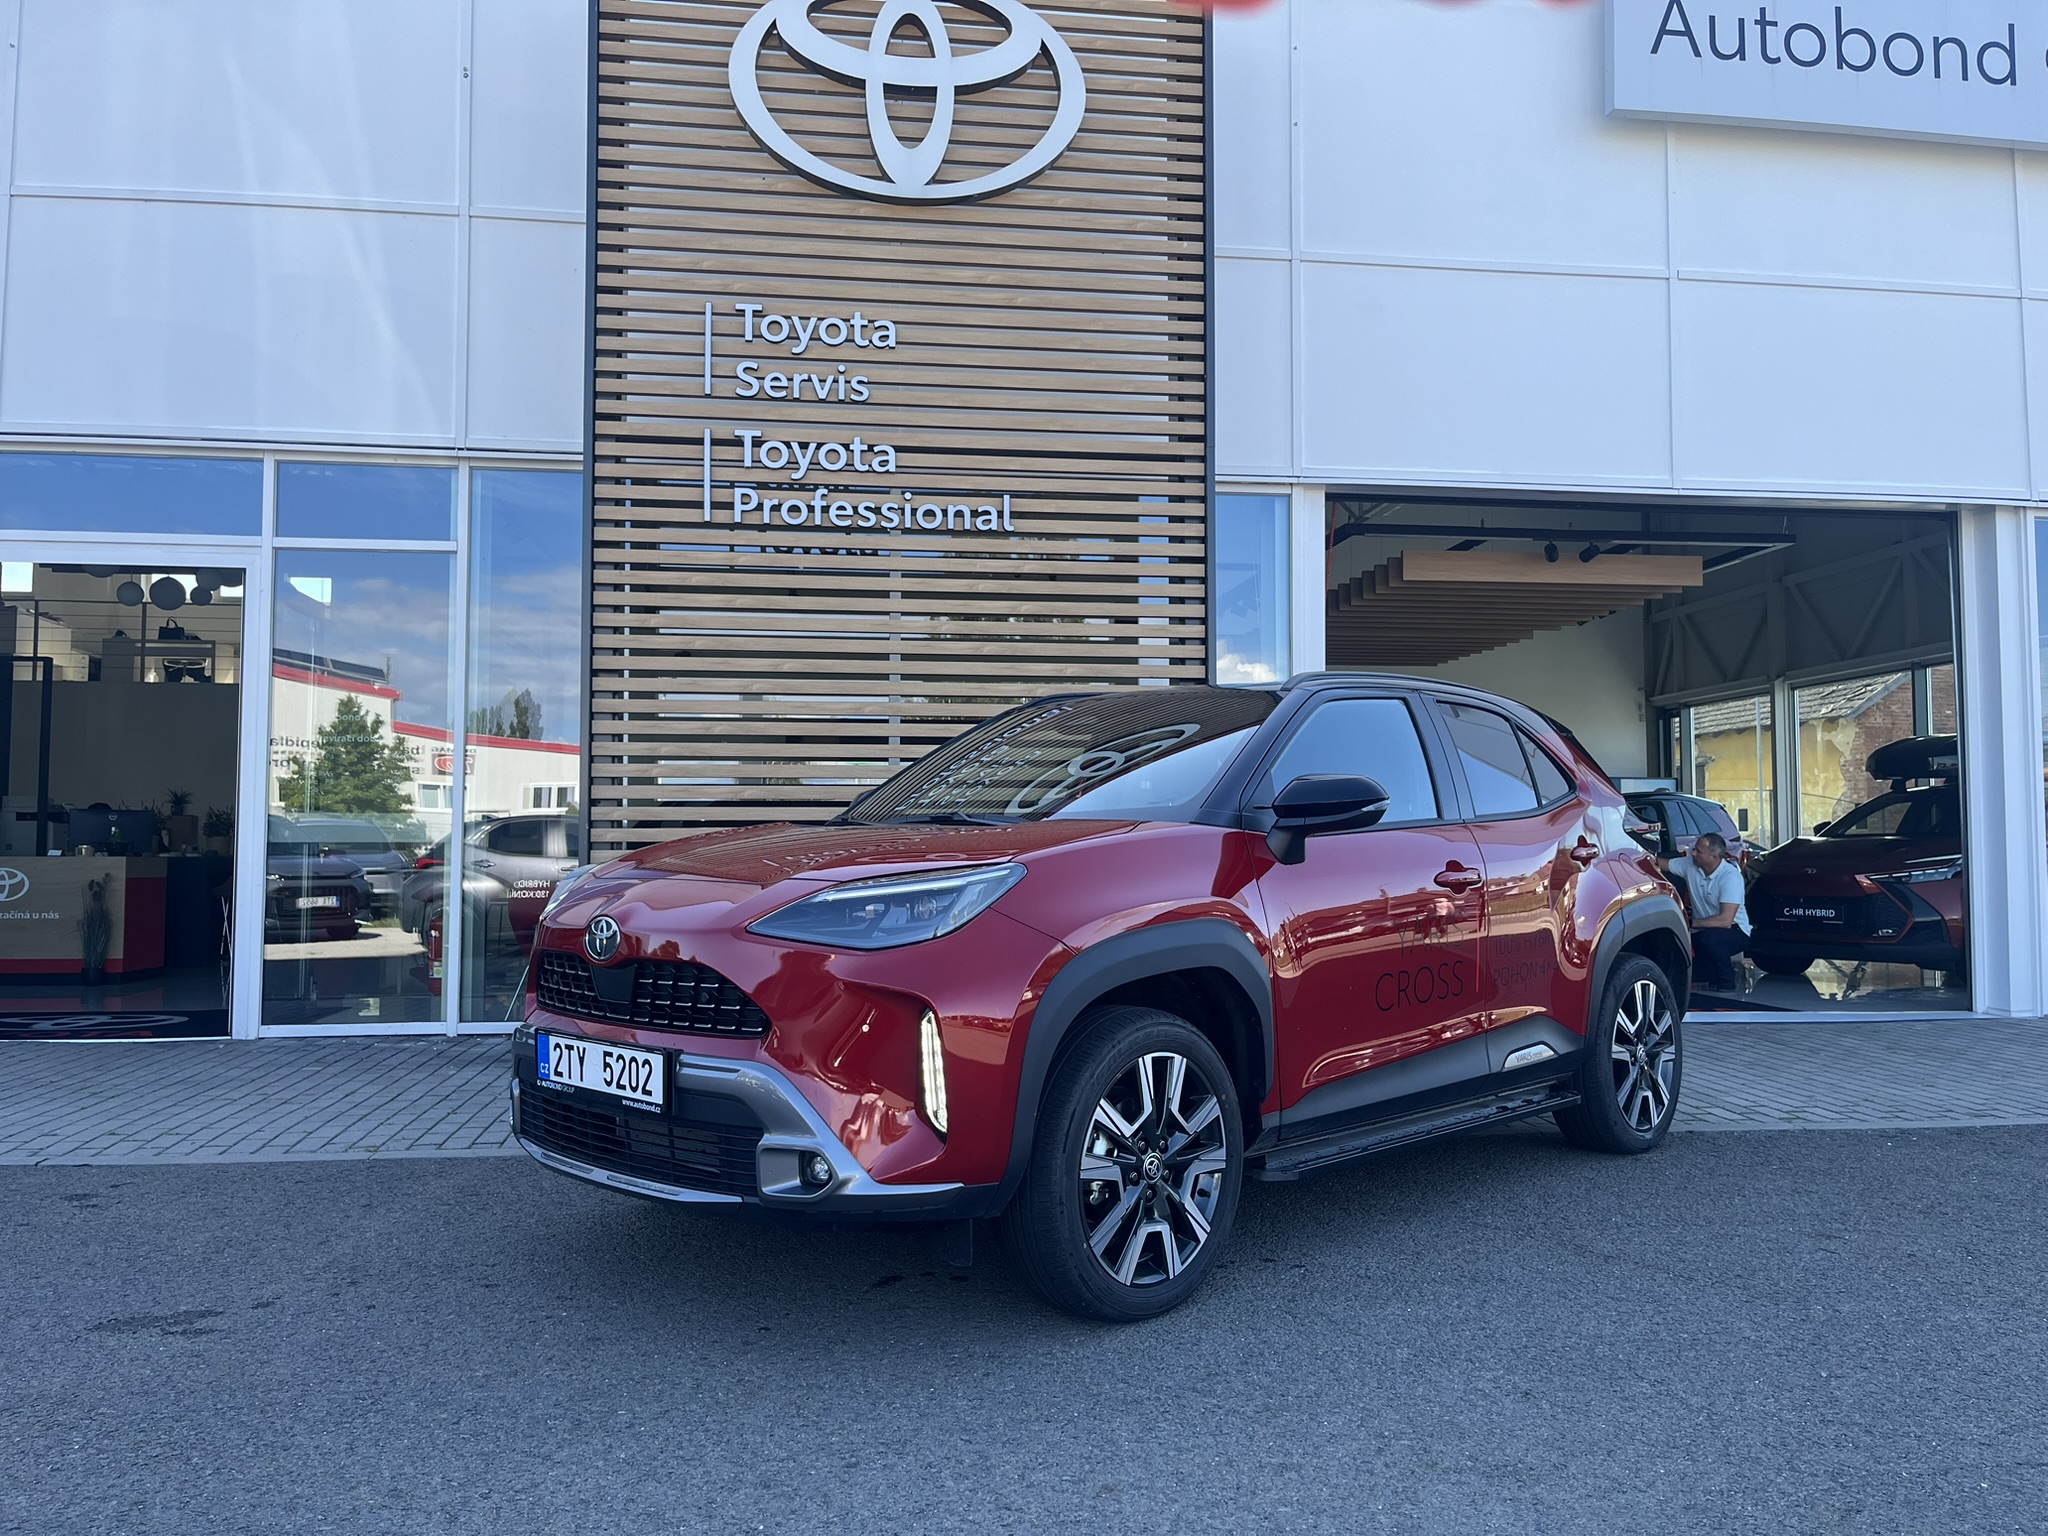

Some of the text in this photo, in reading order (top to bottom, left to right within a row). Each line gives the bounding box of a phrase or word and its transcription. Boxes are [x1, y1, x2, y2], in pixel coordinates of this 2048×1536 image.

[1650, 0, 2017, 86] Autobond
[735, 303, 897, 354] Toyota
[735, 361, 870, 402] Servis
[734, 429, 897, 480] Toyota
[733, 487, 1015, 532] Professional
[32, 912, 39, 920] u
[41, 910, 60, 920] nás
[1784, 907, 1836, 918] C-HR HYBRID
[1375, 960, 1464, 1012] CROSS
[1493, 962, 1538, 987] POHON
[540, 1062, 549, 1074] CZ
[553, 1042, 653, 1097] 2TY 5202
[622, 1099, 661, 1114] www.autobond.cz
